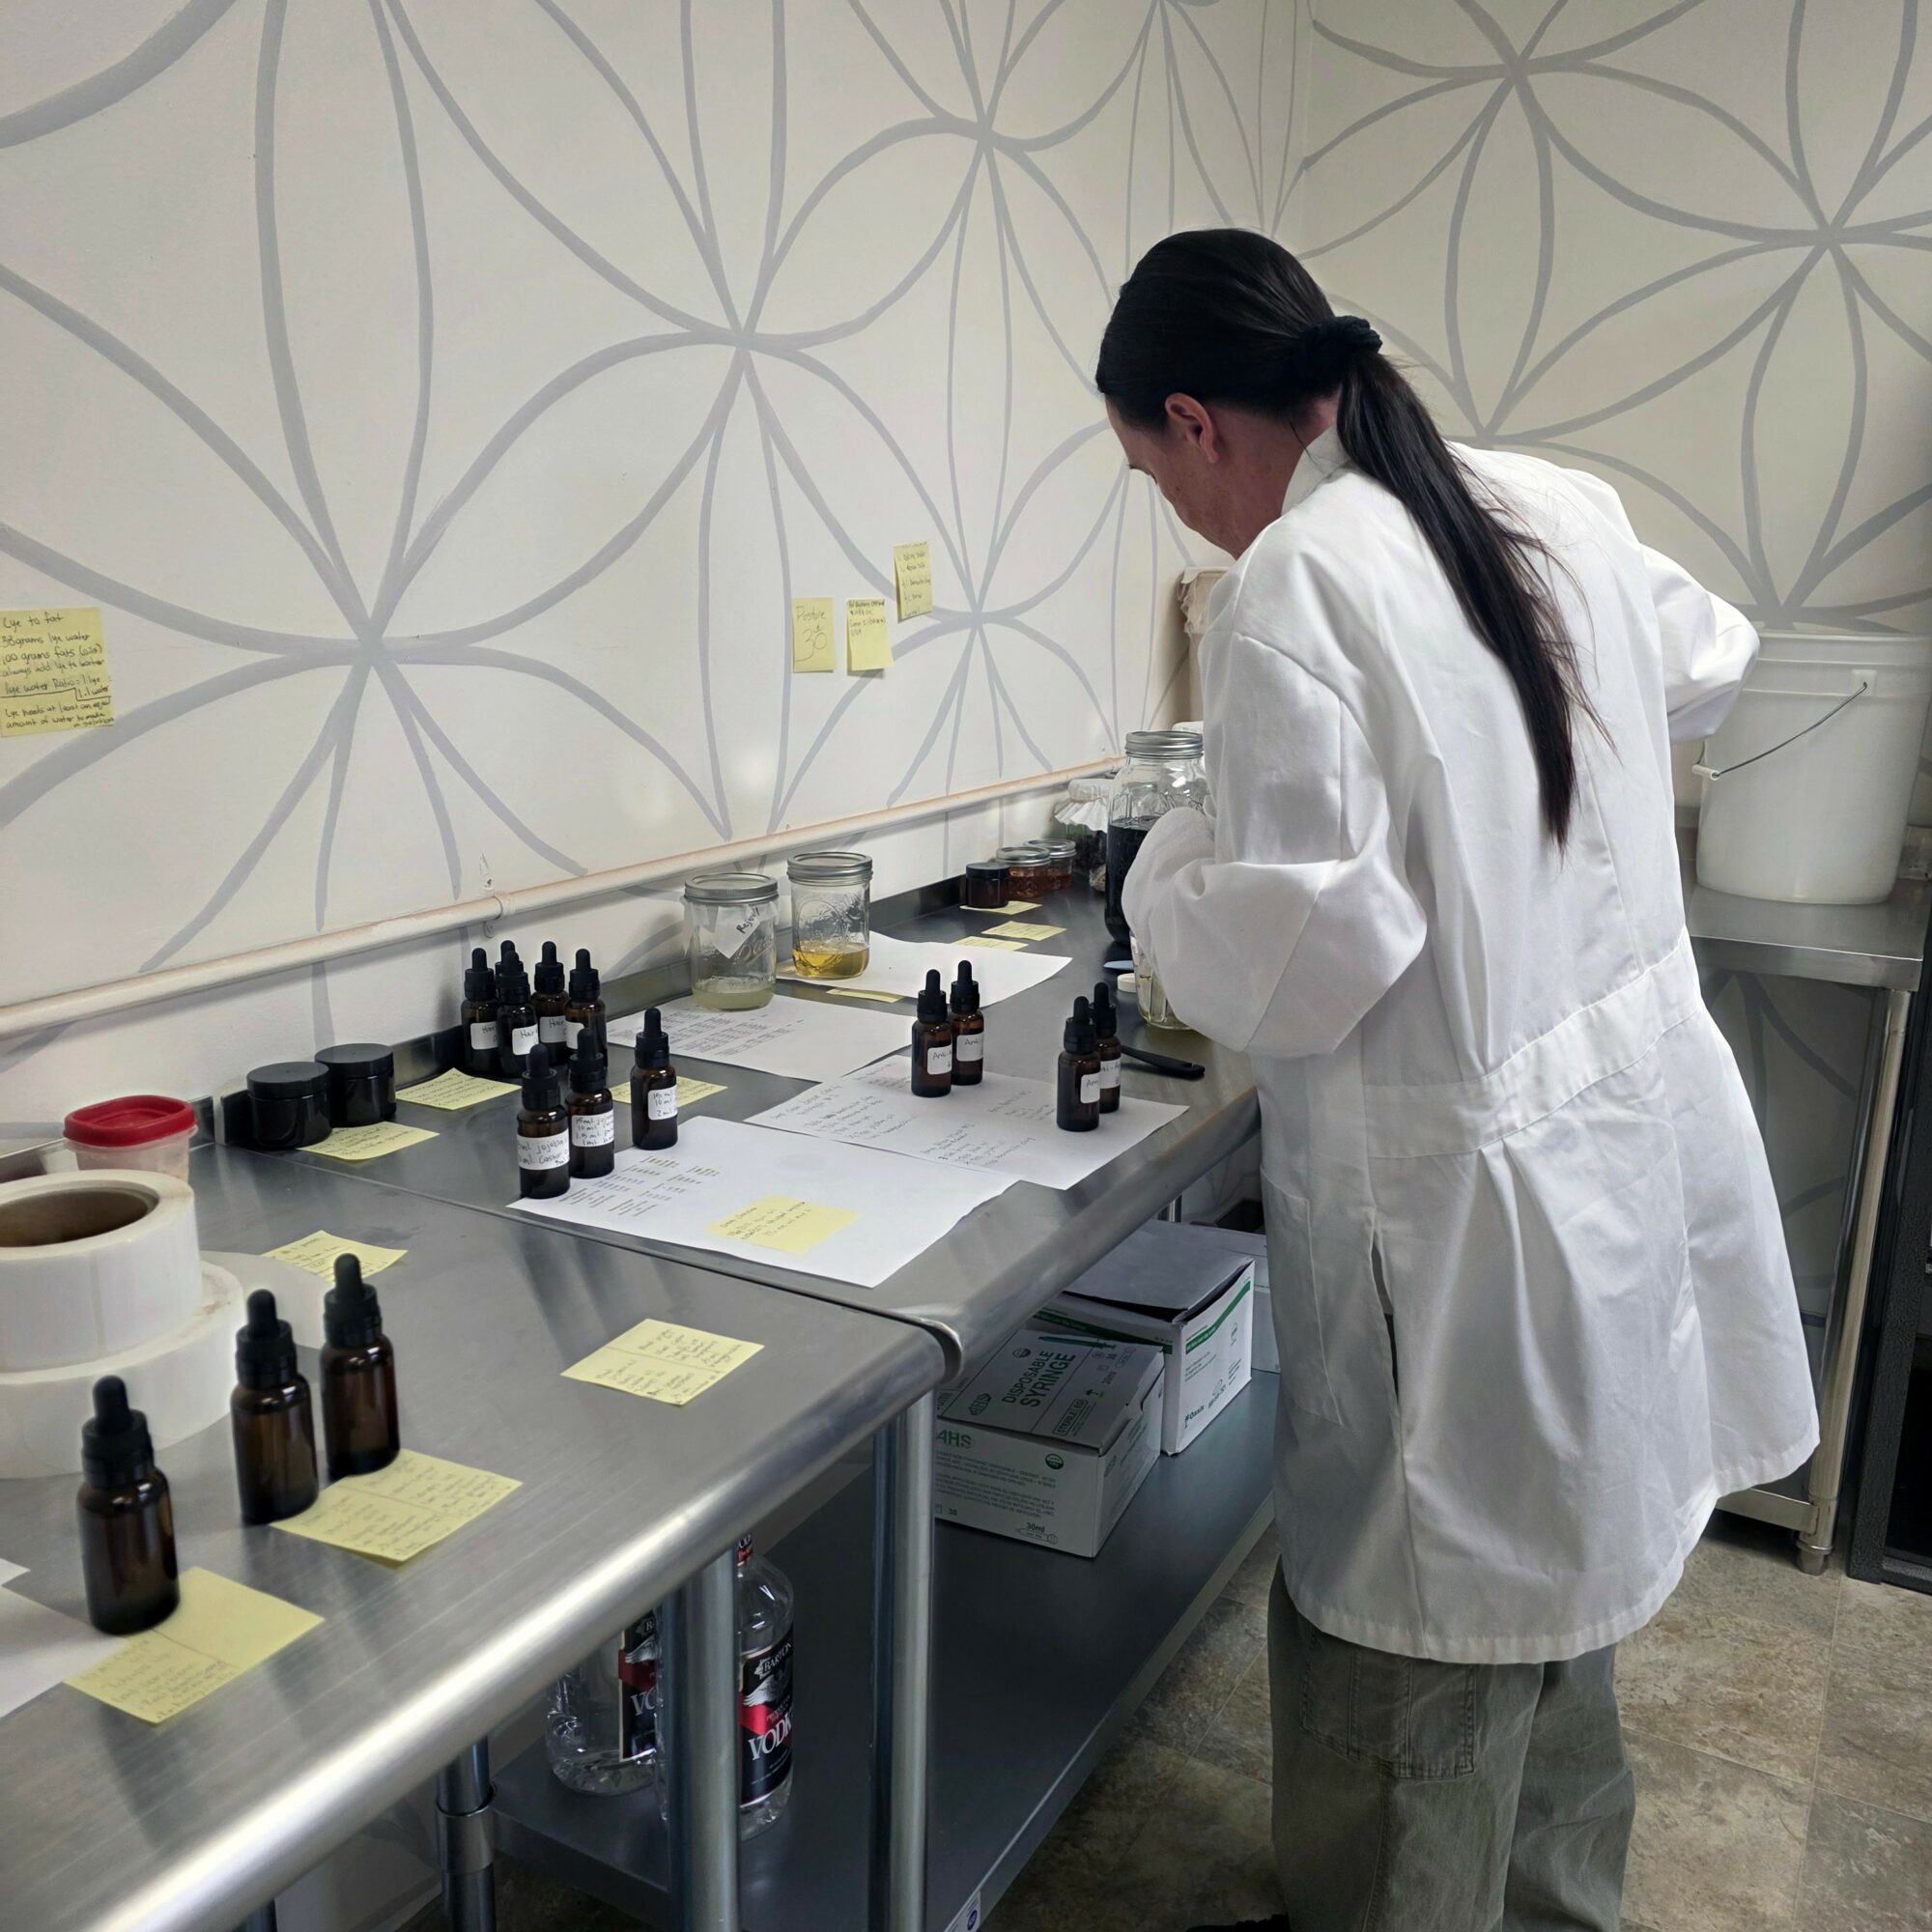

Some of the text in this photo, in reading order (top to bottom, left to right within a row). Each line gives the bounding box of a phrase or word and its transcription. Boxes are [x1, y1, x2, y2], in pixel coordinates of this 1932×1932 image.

[28, 615, 40, 626] to
[44, 611, 64, 624] fat
[65, 630, 91, 641] water
[1001, 1350, 1054, 1404] DISPOSABLE
[1019, 1352, 1076, 1407] SYRINGE
[937, 1429, 973, 1449] AHS
[1026, 1521, 1045, 1533] 30ml
[748, 1711, 793, 1761] VODK
